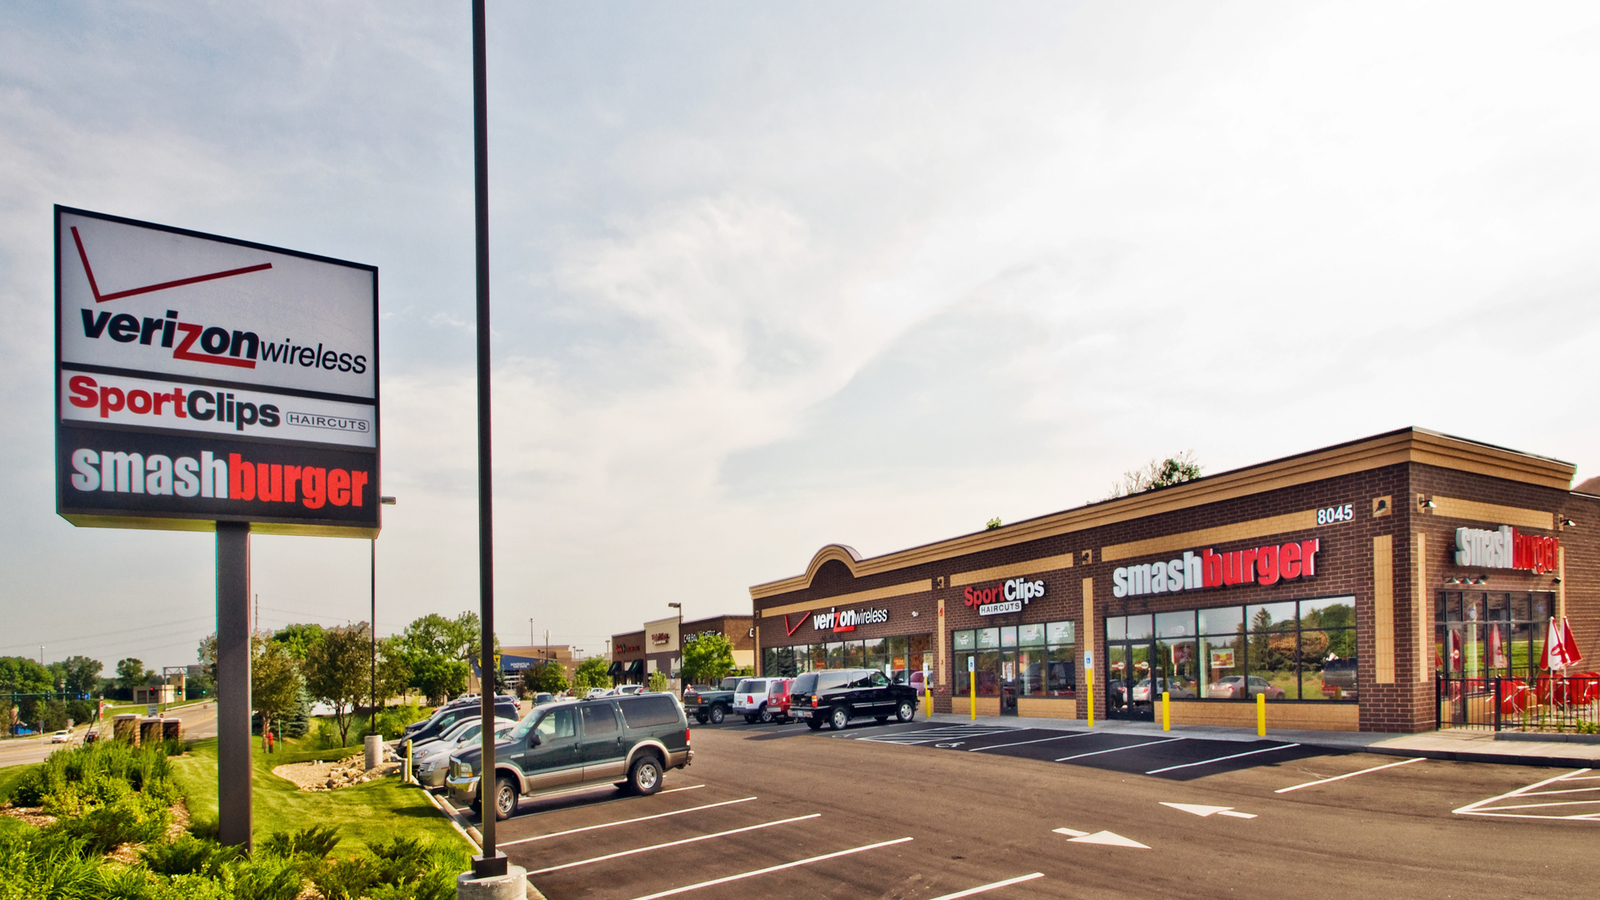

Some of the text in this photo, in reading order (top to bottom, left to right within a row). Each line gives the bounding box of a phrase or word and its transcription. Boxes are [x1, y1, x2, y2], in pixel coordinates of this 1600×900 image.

[290, 414, 366, 431] HAIRCUTS
[71, 448, 368, 510] smashburger
[1317, 504, 1353, 525] 8045
[1455, 525, 1559, 575] smashburger
[1113, 538, 1320, 598] smashburger
[980, 602, 1021, 614] HAIRCUTS
